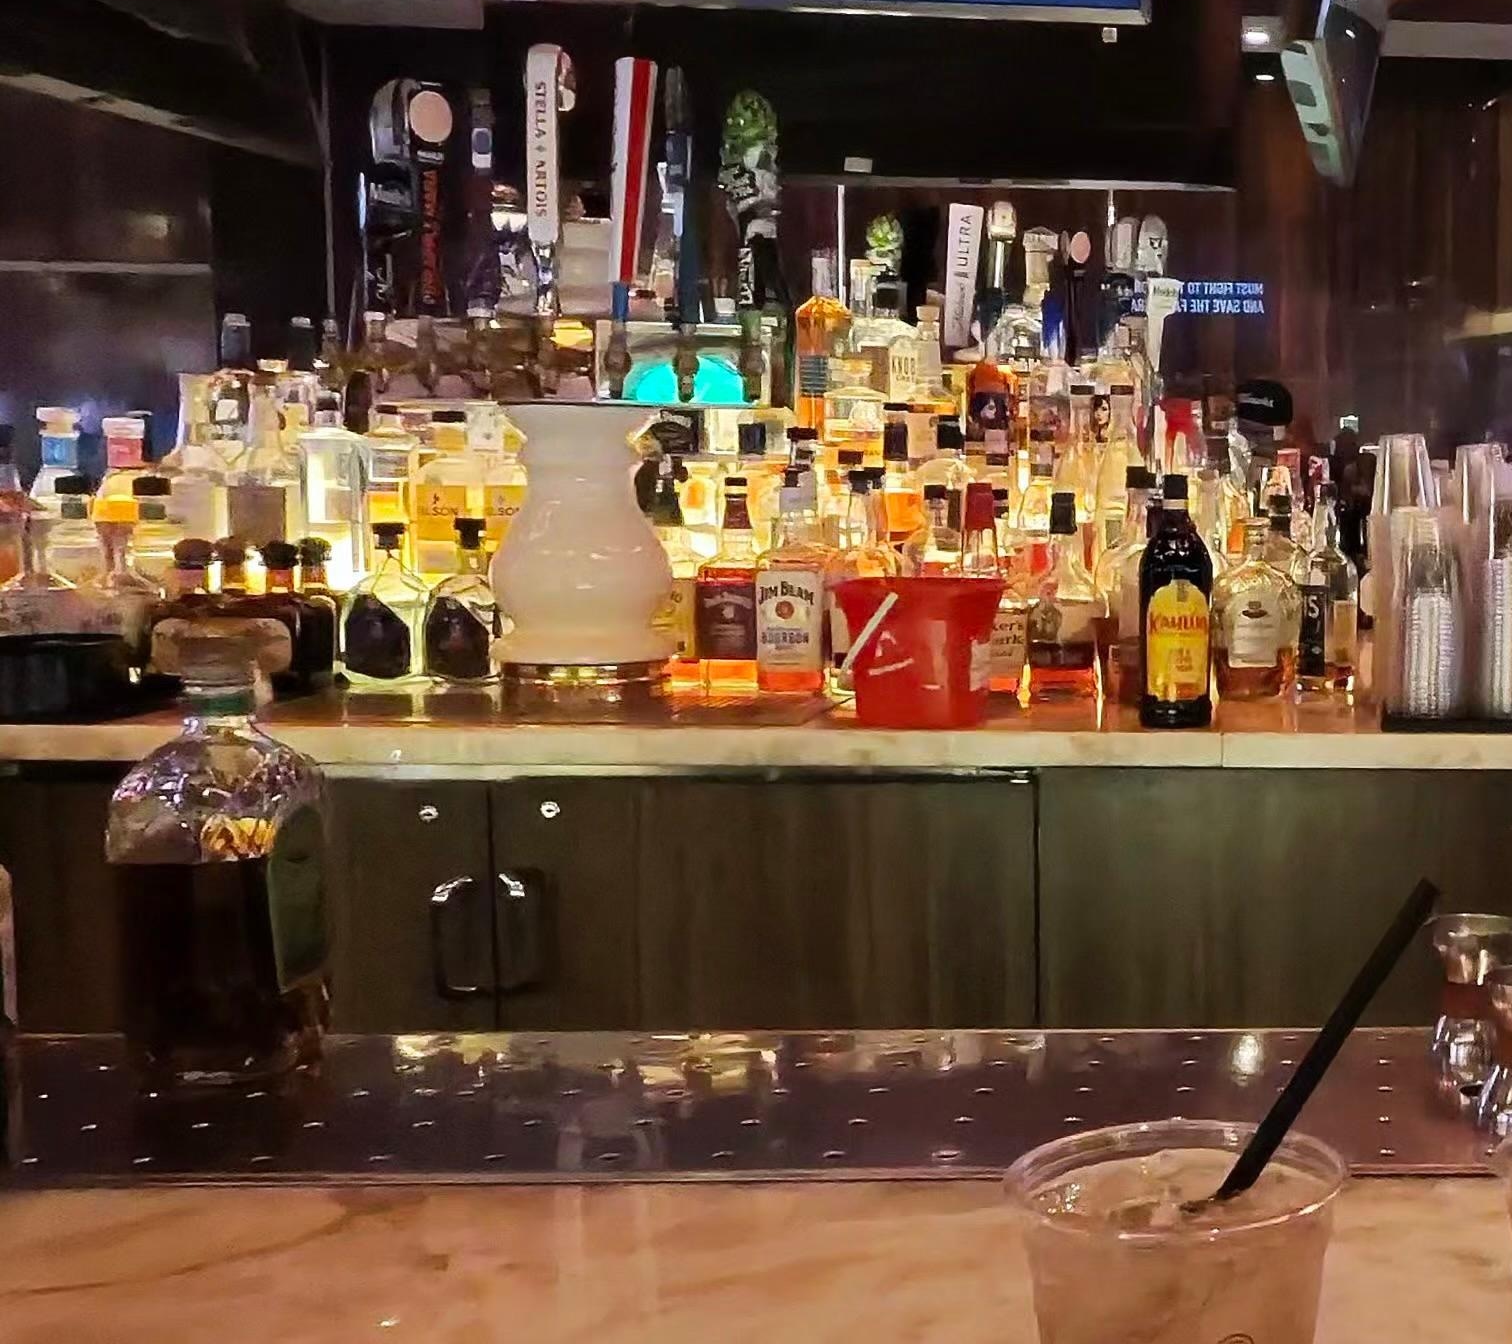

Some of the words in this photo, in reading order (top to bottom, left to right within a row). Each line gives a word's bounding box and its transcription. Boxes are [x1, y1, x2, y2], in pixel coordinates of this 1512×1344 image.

[535, 81, 547, 139] STELLA
[535, 159, 547, 218] ARTOIS
[957, 214, 973, 267] ULTRA
[758, 585, 779, 606] JIM
[780, 580, 815, 606] BEAM
